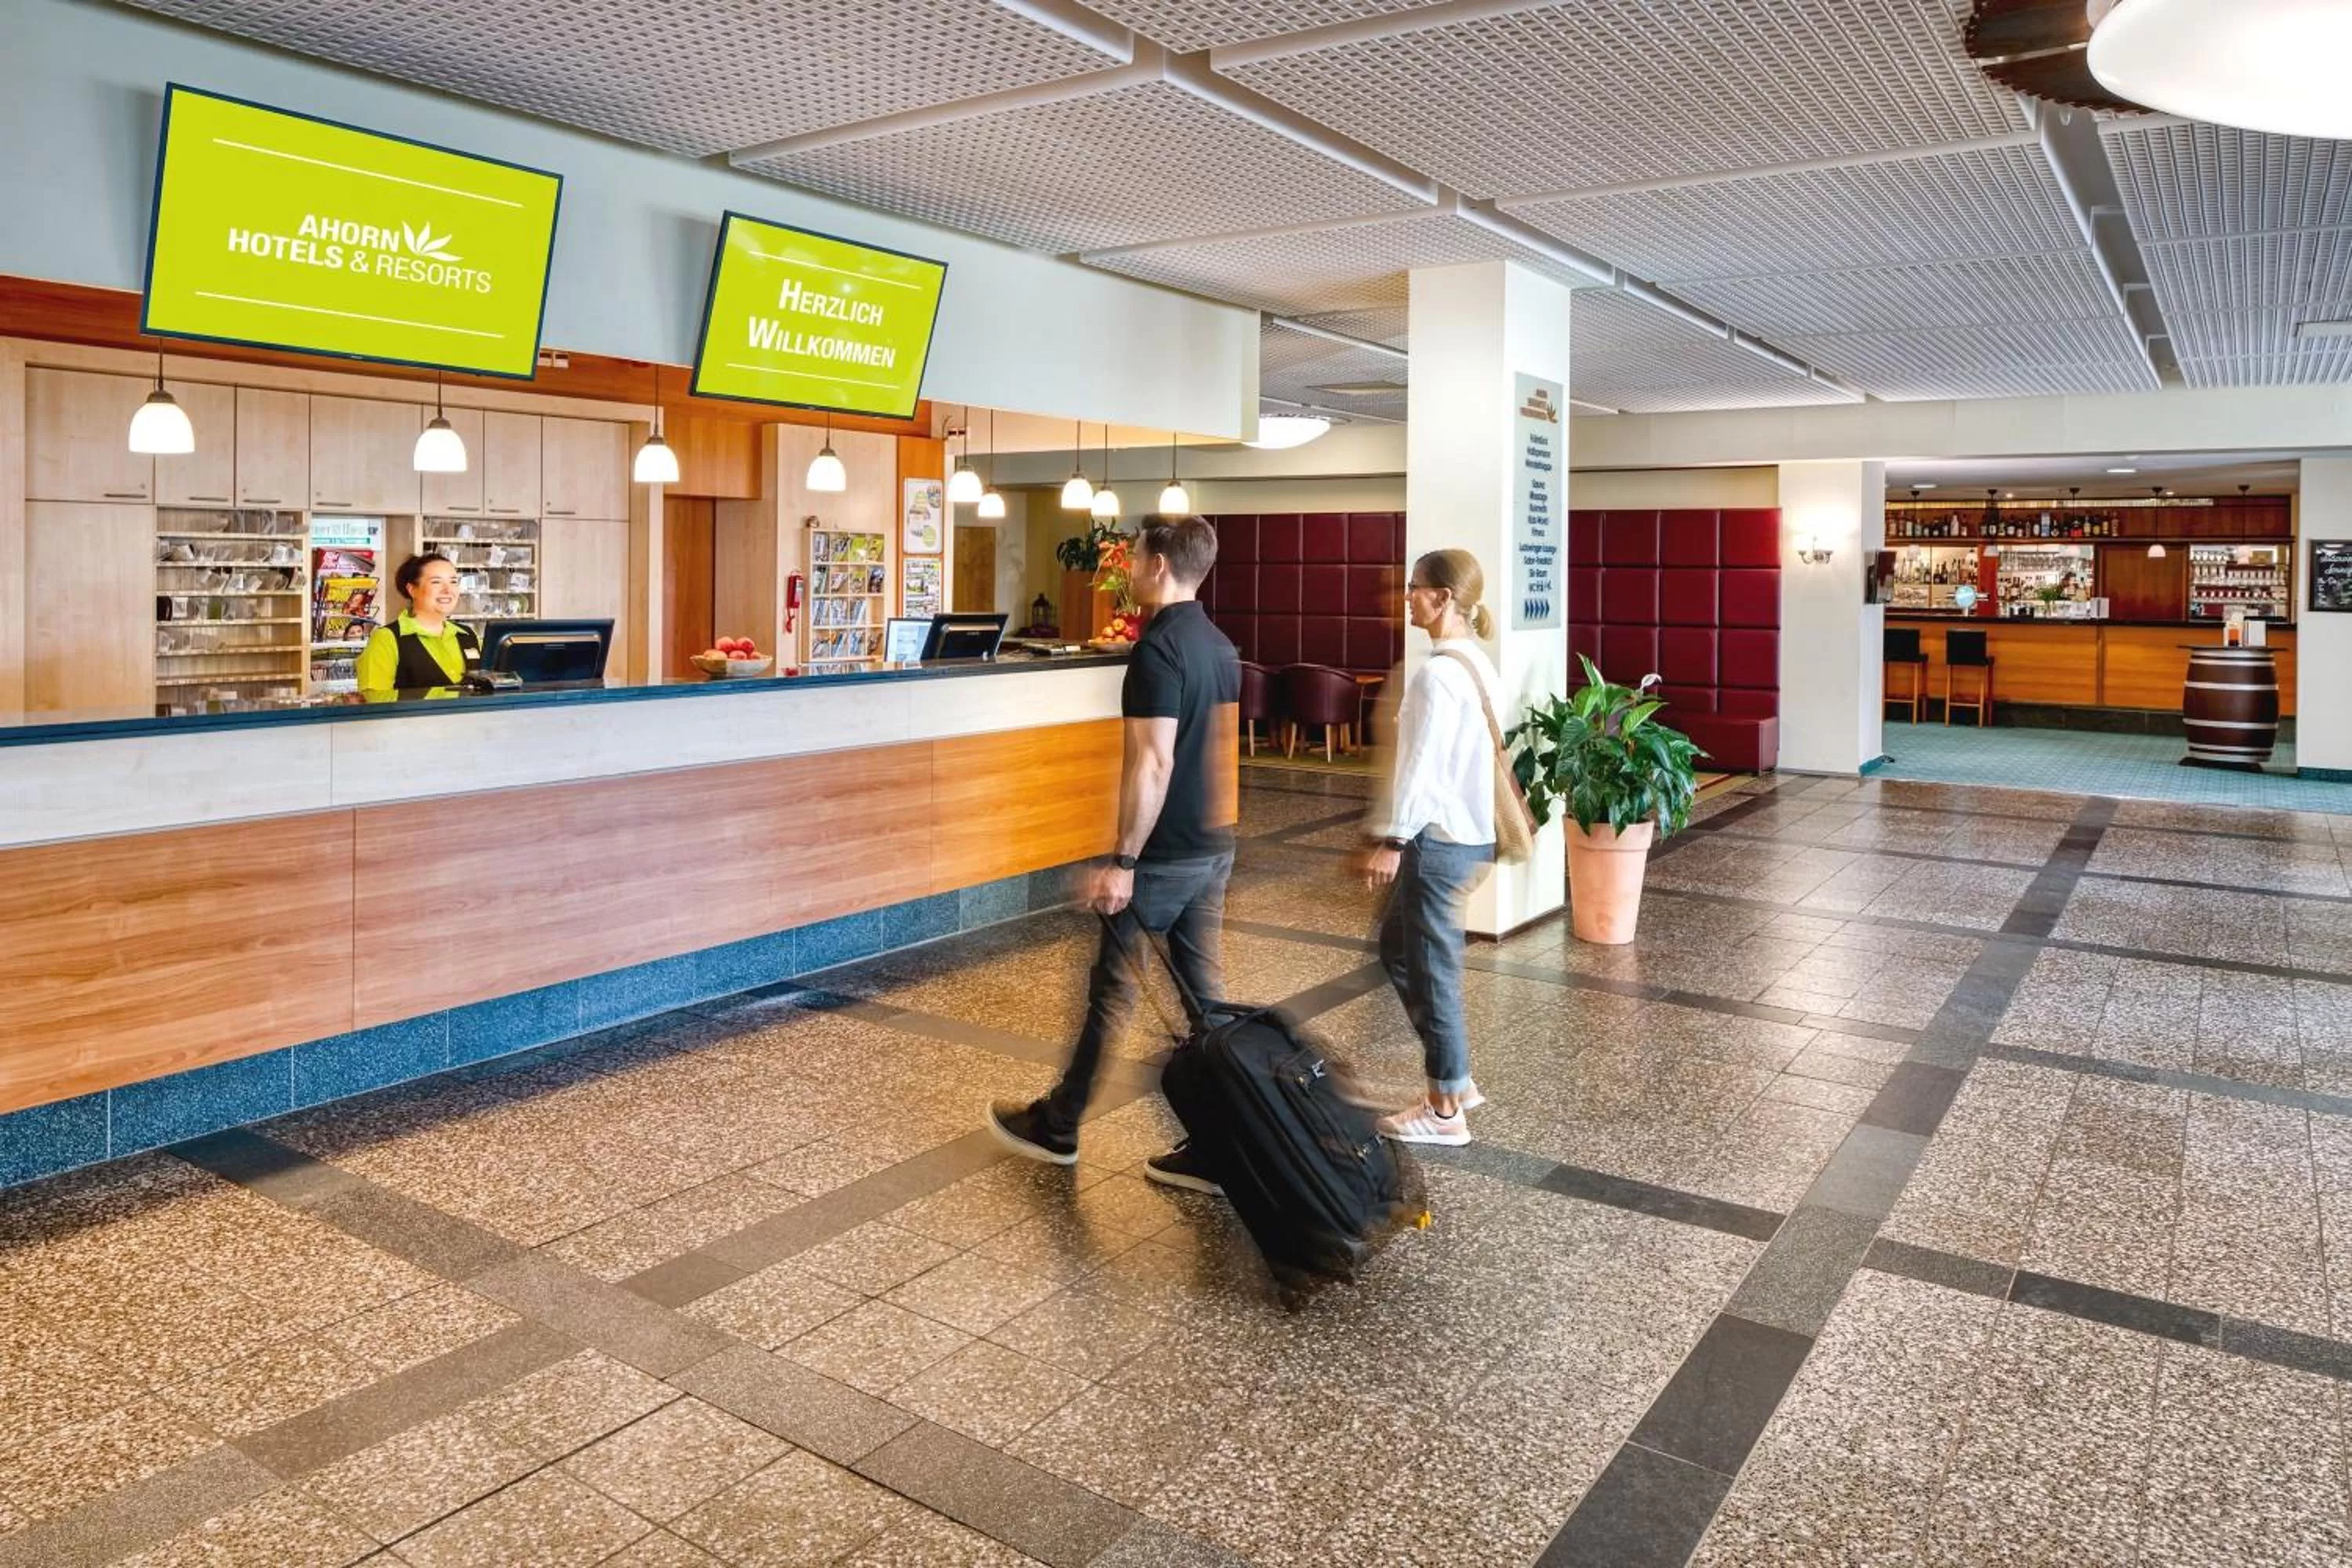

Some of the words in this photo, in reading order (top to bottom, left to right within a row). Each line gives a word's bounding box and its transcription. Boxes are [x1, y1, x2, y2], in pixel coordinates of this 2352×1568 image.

[297, 213, 400, 252] AHORN
[228, 227, 343, 269] HOTELS
[349, 250, 369, 273] &
[376, 253, 492, 294] RESORTS
[779, 278, 884, 327] HERZLICH
[748, 315, 897, 369] WILLKOMMEN
